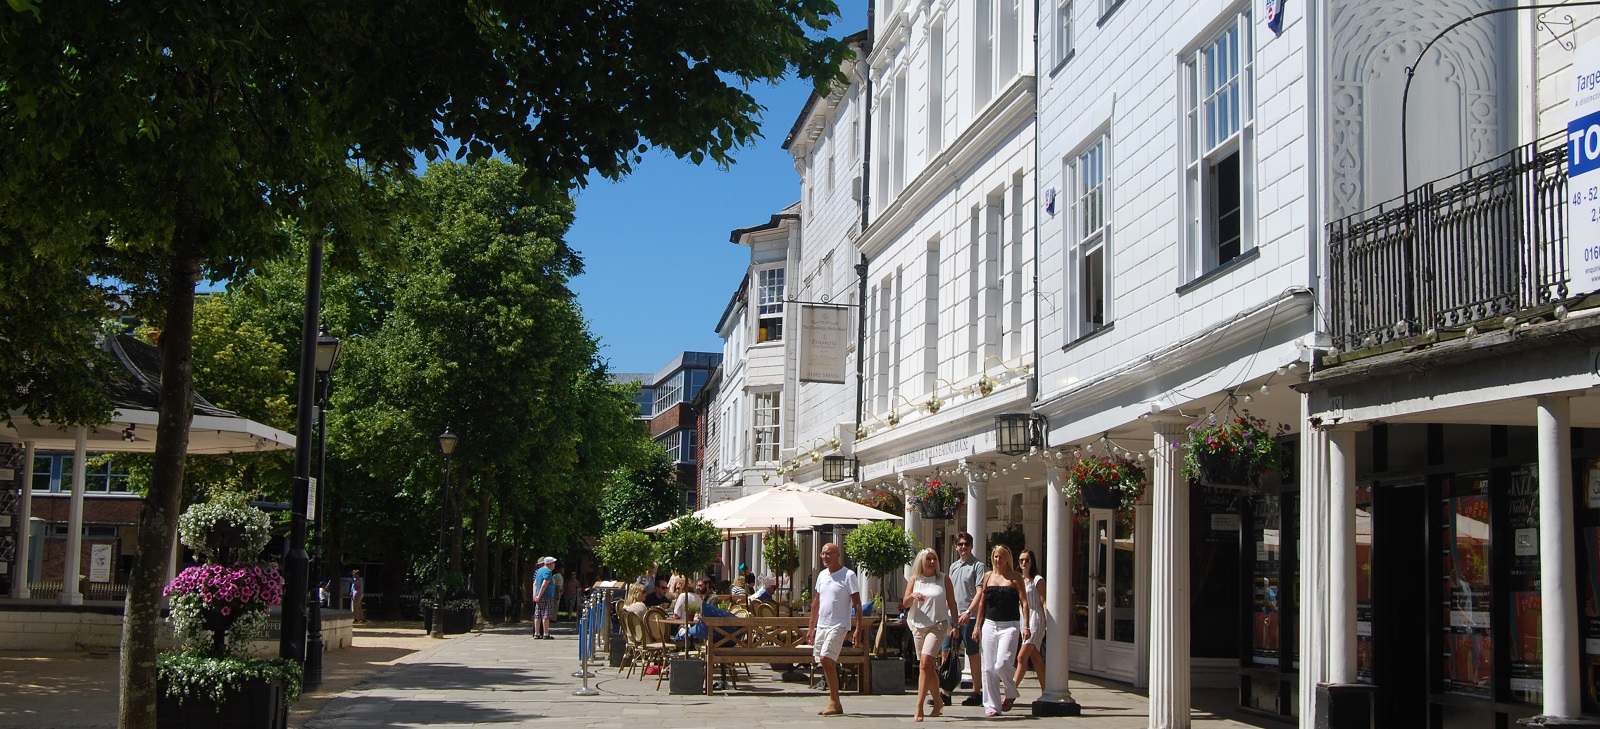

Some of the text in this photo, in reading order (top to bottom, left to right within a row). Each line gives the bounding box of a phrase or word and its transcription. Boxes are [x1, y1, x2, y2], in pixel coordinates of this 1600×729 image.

[1569, 124, 1600, 166] TO
[1573, 192, 1581, 206] 48
[1588, 186, 1598, 201] 52
